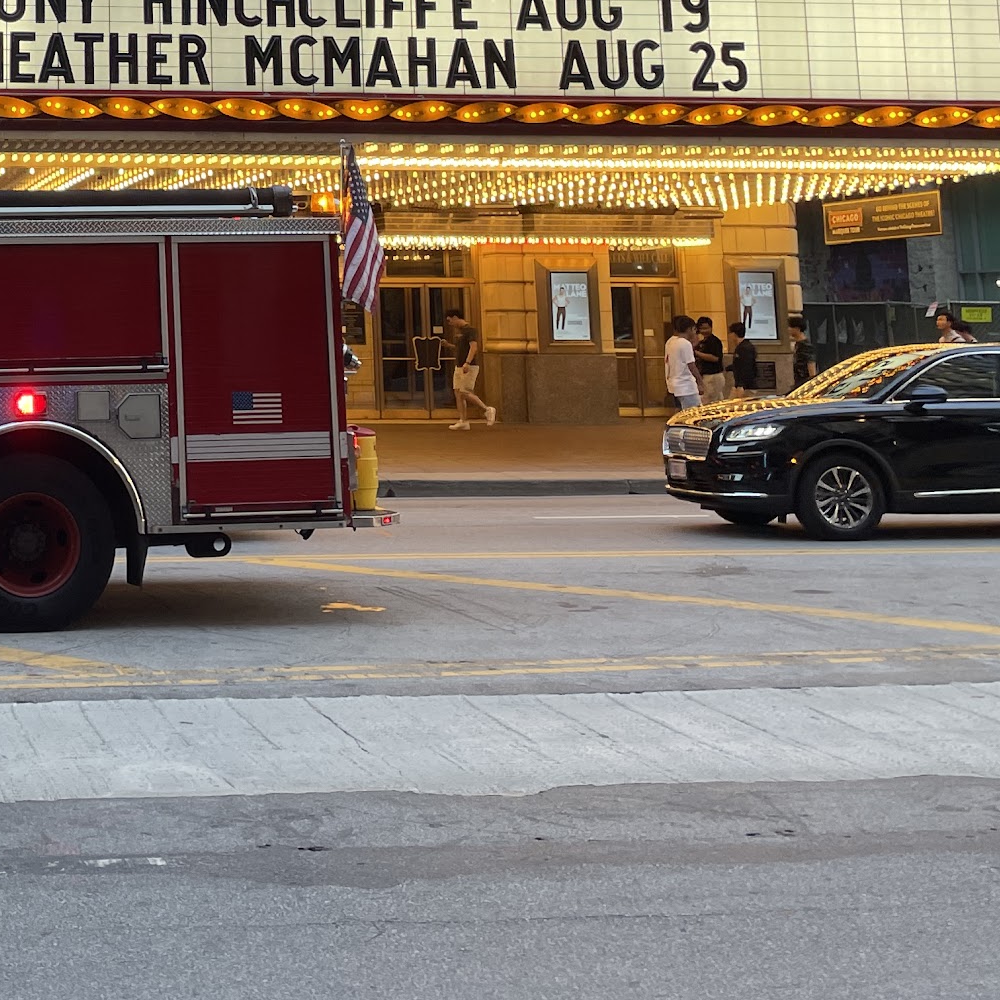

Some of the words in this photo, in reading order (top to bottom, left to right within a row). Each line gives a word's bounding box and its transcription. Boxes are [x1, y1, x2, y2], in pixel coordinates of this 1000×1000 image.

[244, 34, 517, 89] MCMAHAN
[559, 39, 664, 90] AUG
[689, 41, 748, 92] 25
[832, 213, 859, 223] CHICAGO
[553, 283, 587, 291] MATTEO
